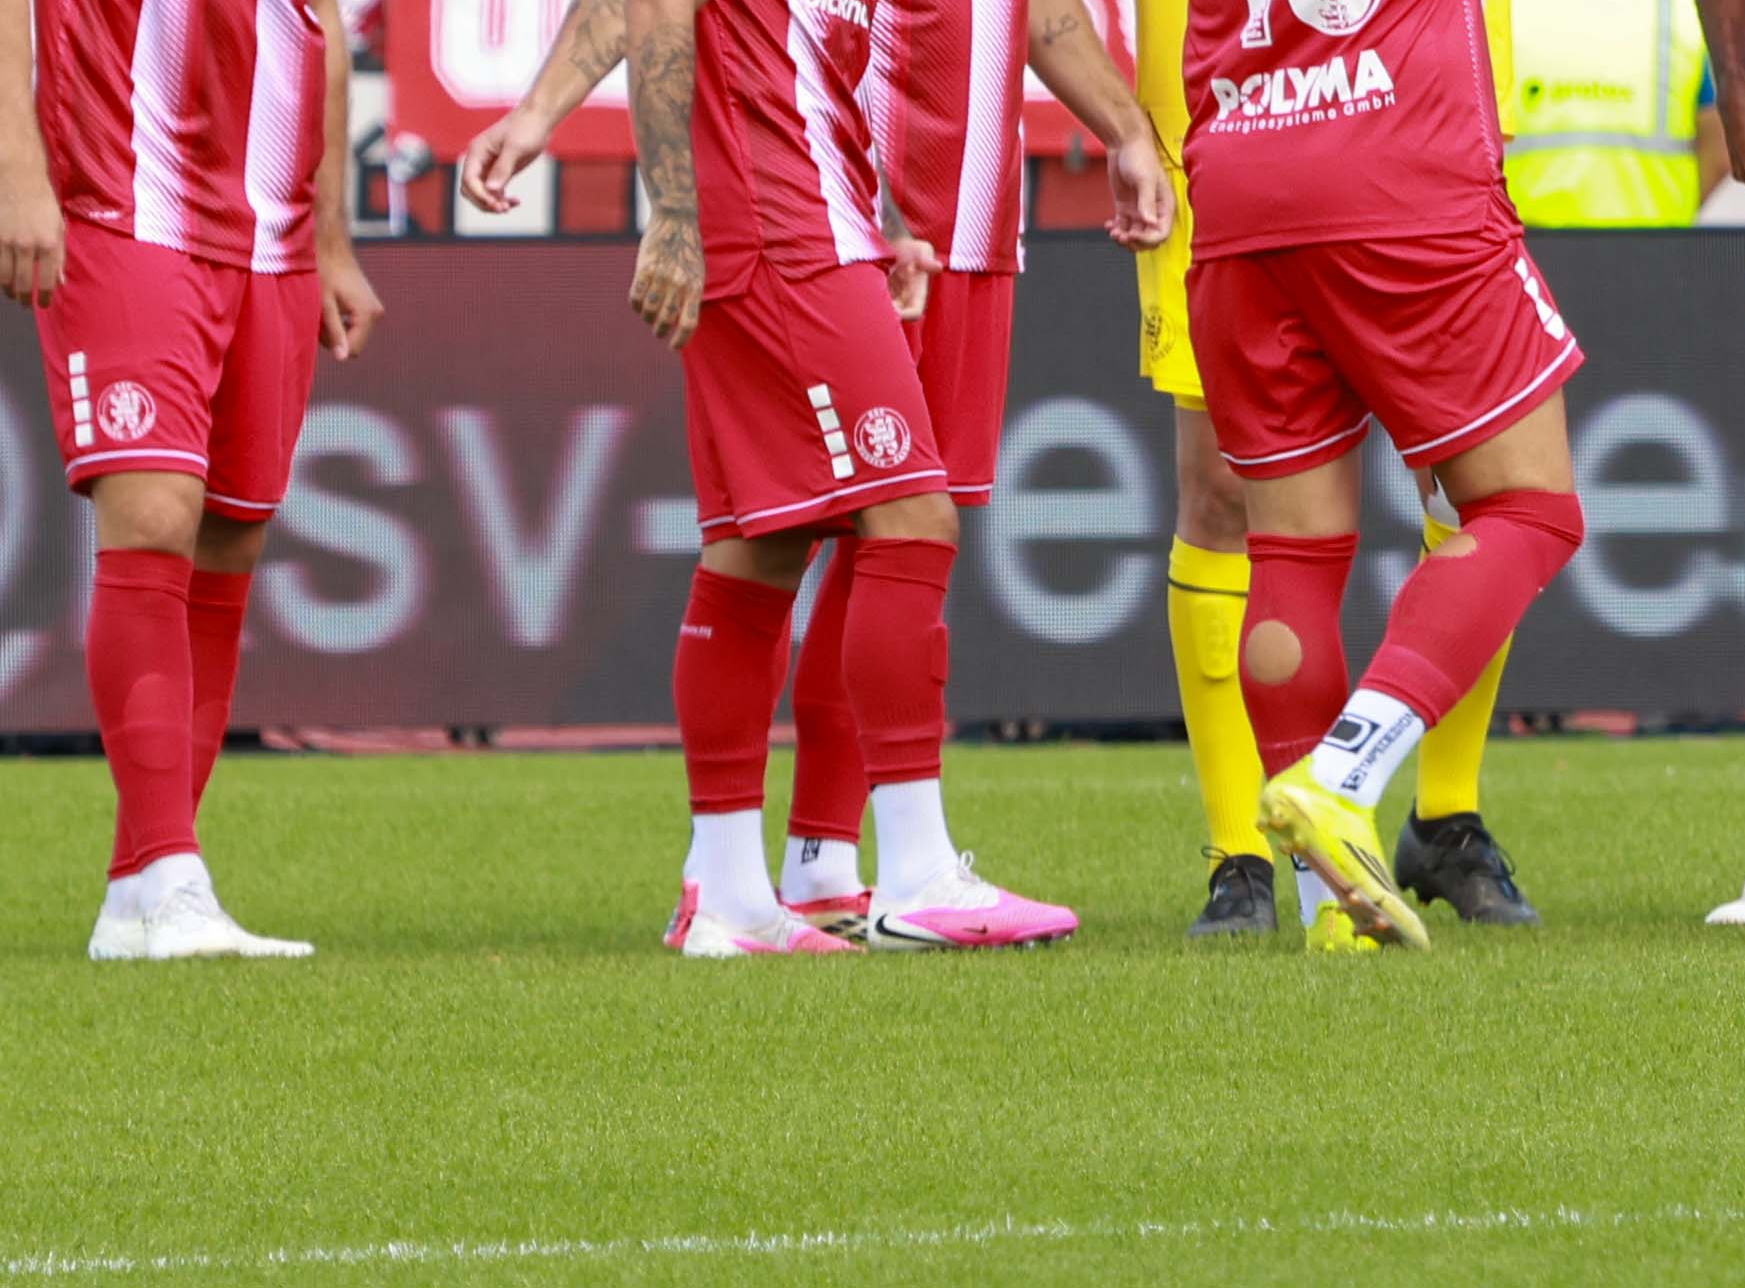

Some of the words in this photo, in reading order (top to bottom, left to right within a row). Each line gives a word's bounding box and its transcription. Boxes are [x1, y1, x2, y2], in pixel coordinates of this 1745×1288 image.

[1208, 108, 1337, 136] Energiesysteme
[1342, 92, 1397, 117] GmbH
[1209, 48, 1395, 122] POLYMA
